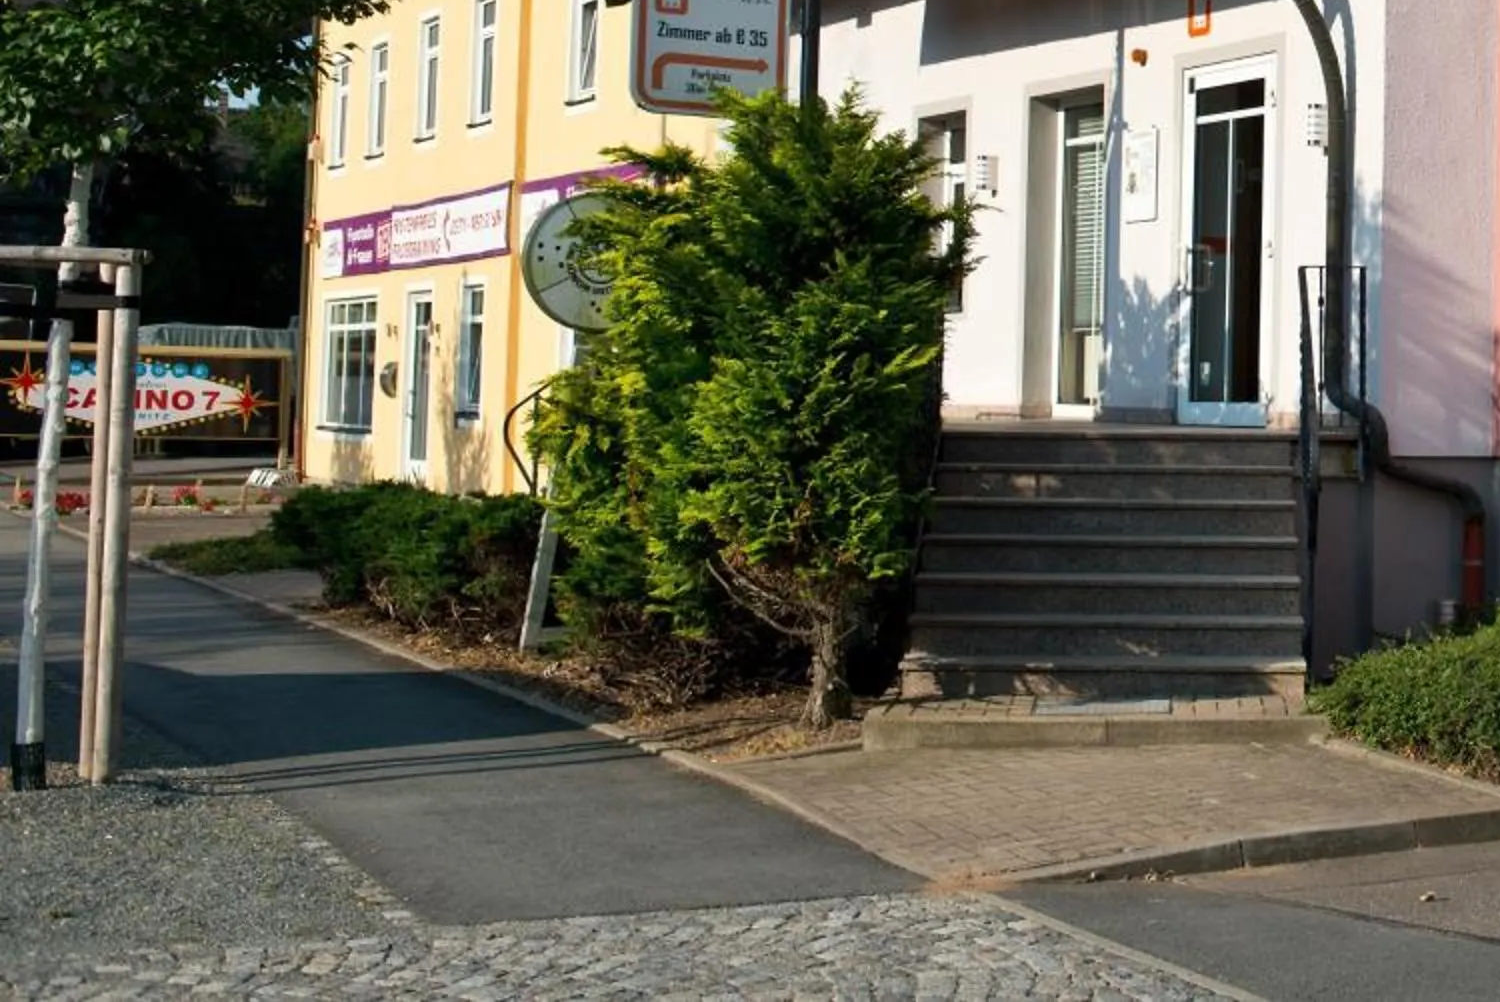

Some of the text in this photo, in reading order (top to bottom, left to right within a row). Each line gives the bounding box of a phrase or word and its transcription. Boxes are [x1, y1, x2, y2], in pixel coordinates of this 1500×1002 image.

[656, 19, 711, 41] Zimmer
[715, 27, 732, 44] ab
[749, 30, 769, 47] 35
[65, 388, 221, 411] CAINO 7
